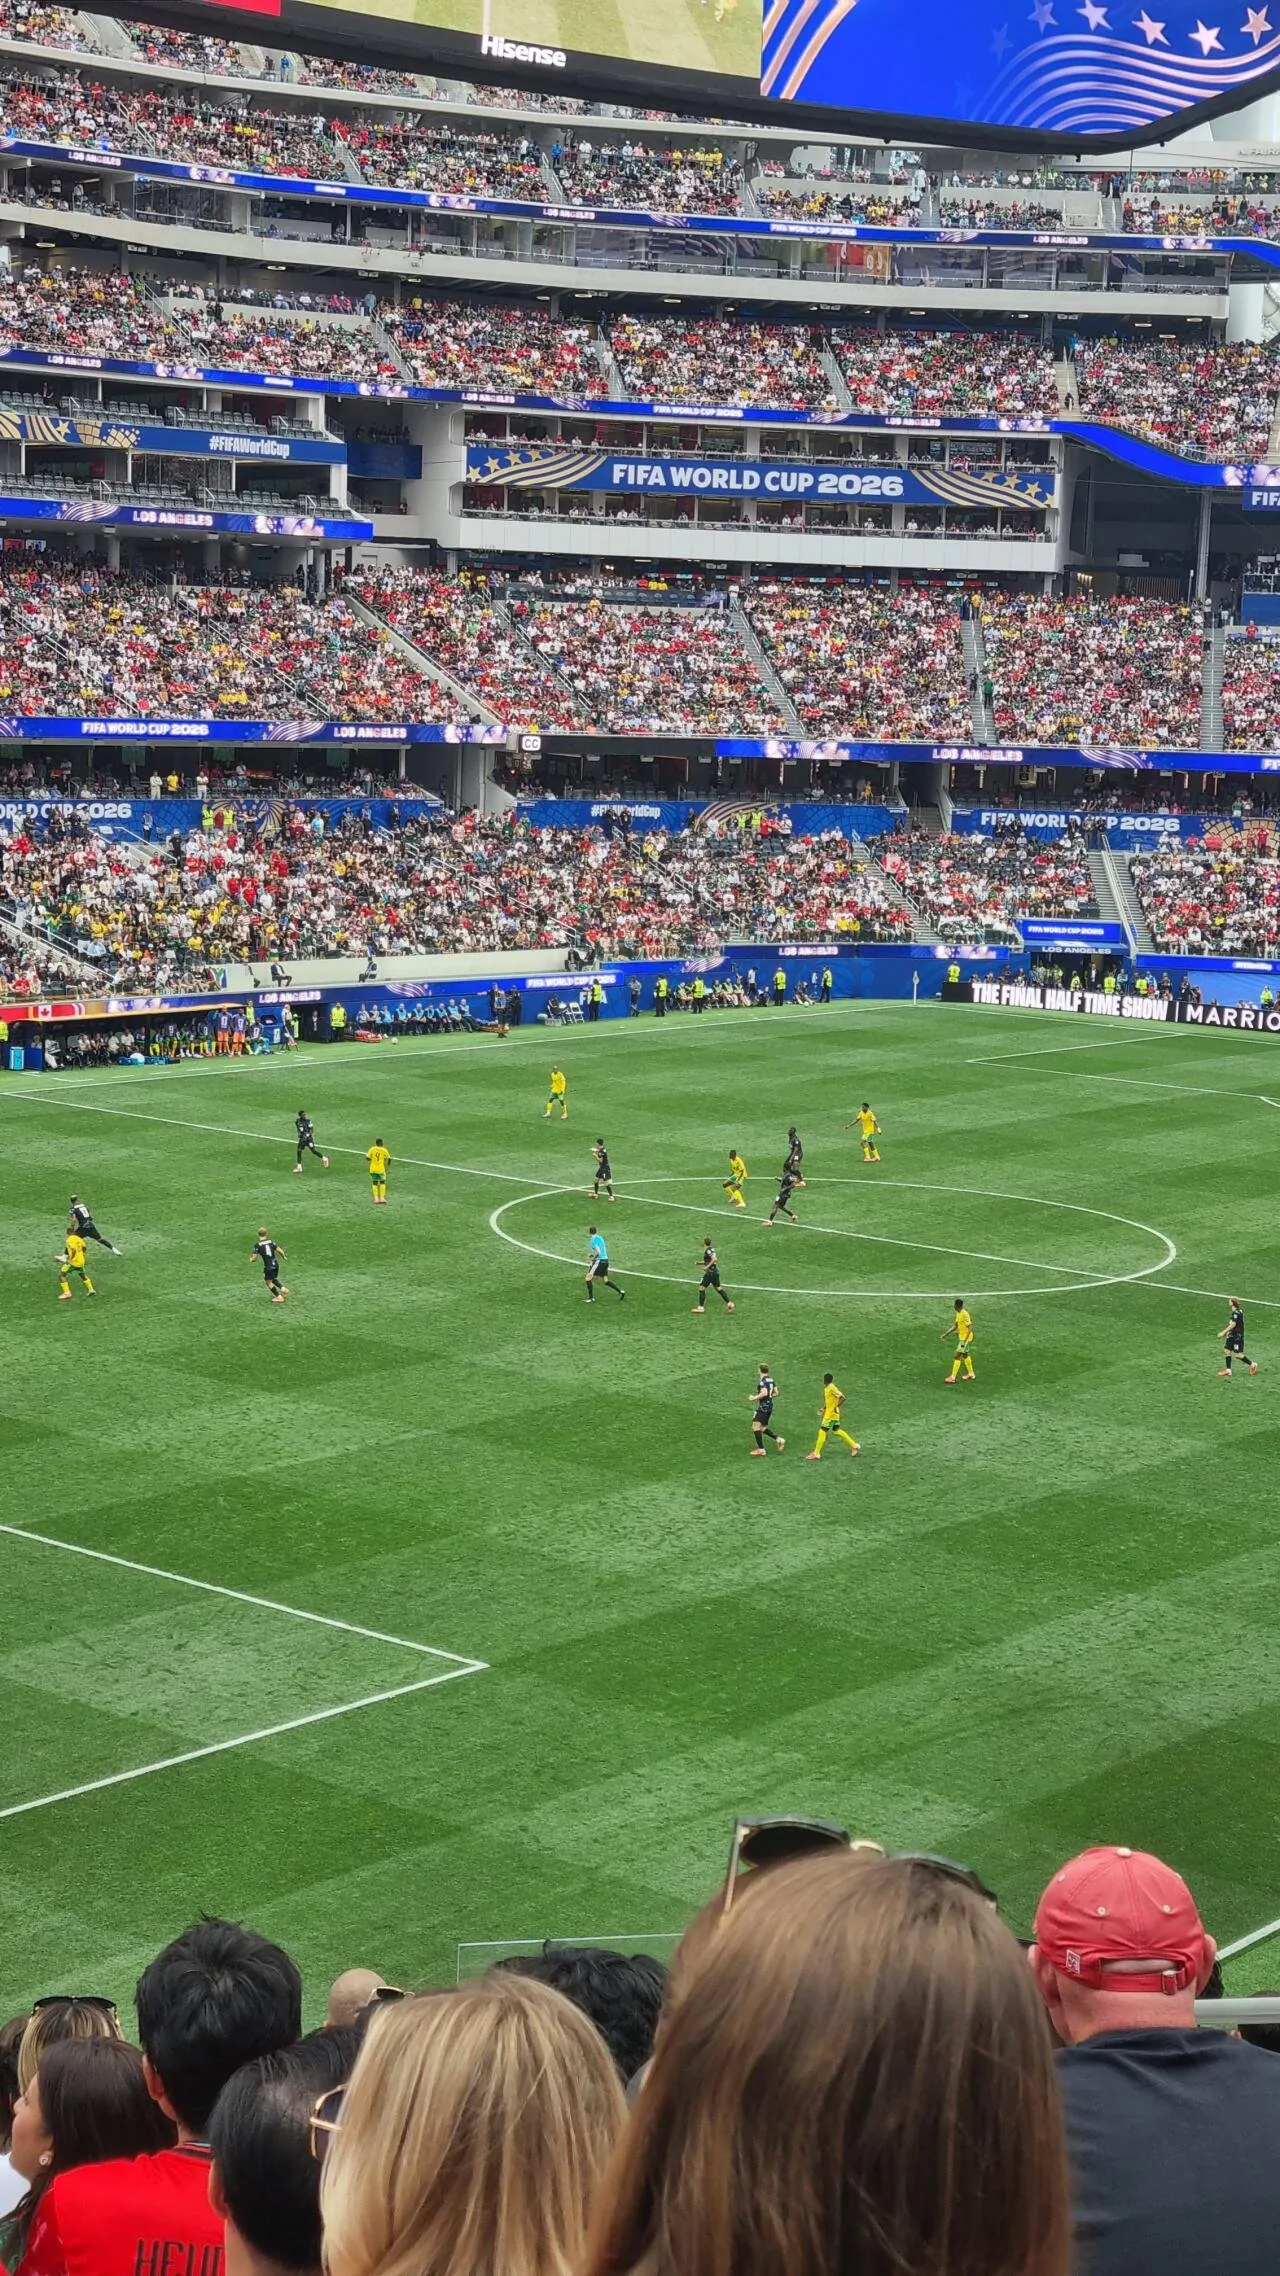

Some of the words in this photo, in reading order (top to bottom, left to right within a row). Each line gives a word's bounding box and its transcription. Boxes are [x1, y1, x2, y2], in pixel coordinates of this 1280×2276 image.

[480, 35, 567, 67] Hisense
[68, 151, 84, 161] LOS
[85, 154, 121, 166] ANGELES
[559, 209, 595, 220] ANGELES
[1051, 236, 1088, 244] ANGELES
[47, 355, 64, 364] LOS
[65, 357, 101, 368] ANGELES
[461, 392, 478, 401] LOS
[479, 394, 515, 404] ANGELES
[653, 405, 670, 414] FIFA
[670, 406, 699, 416] WORLD
[885, 417, 901, 425] LOS
[902, 418, 941, 427] ANGELES
[209, 435, 290, 460] #FIFAWorldCup
[612, 464, 666, 487] FIFA
[669, 466, 761, 491] WORLD
[764, 472, 815, 493] CUP
[817, 474, 905, 496] 2026
[1252, 491, 1280, 506] FIF
[132, 510, 157, 523] LOS
[158, 512, 213, 527] ANGELES
[81, 721, 107, 735] FIFA
[107, 722, 148, 735] WORLD
[148, 723, 170, 735] CUP
[169, 724, 210, 736] 2026
[334, 727, 356, 738] LOS
[357, 727, 407, 739] ANGELES
[524, 738, 540, 749] CC
[932, 748, 959, 760] LOS
[961, 748, 1023, 762] ANGELES
[1120, 816, 1180, 832] 2026
[779, 946, 797, 955] LOS
[798, 946, 839, 955] ANGELES
[1064, 946, 1112, 955] ANGELES
[526, 978, 545, 989] FIFA
[546, 976, 573, 988] WORLD
[259, 993, 278, 1004] LOS
[279, 990, 322, 1003] ANGELES
[971, 983, 1001, 1005] THE
[1001, 985, 1044, 1009] FINAL
[1045, 988, 1084, 1013] HALF
[1083, 992, 1121, 1017] TIME
[1121, 995, 1169, 1021] SHOW
[1186, 1004, 1280, 1030] MARRIO
